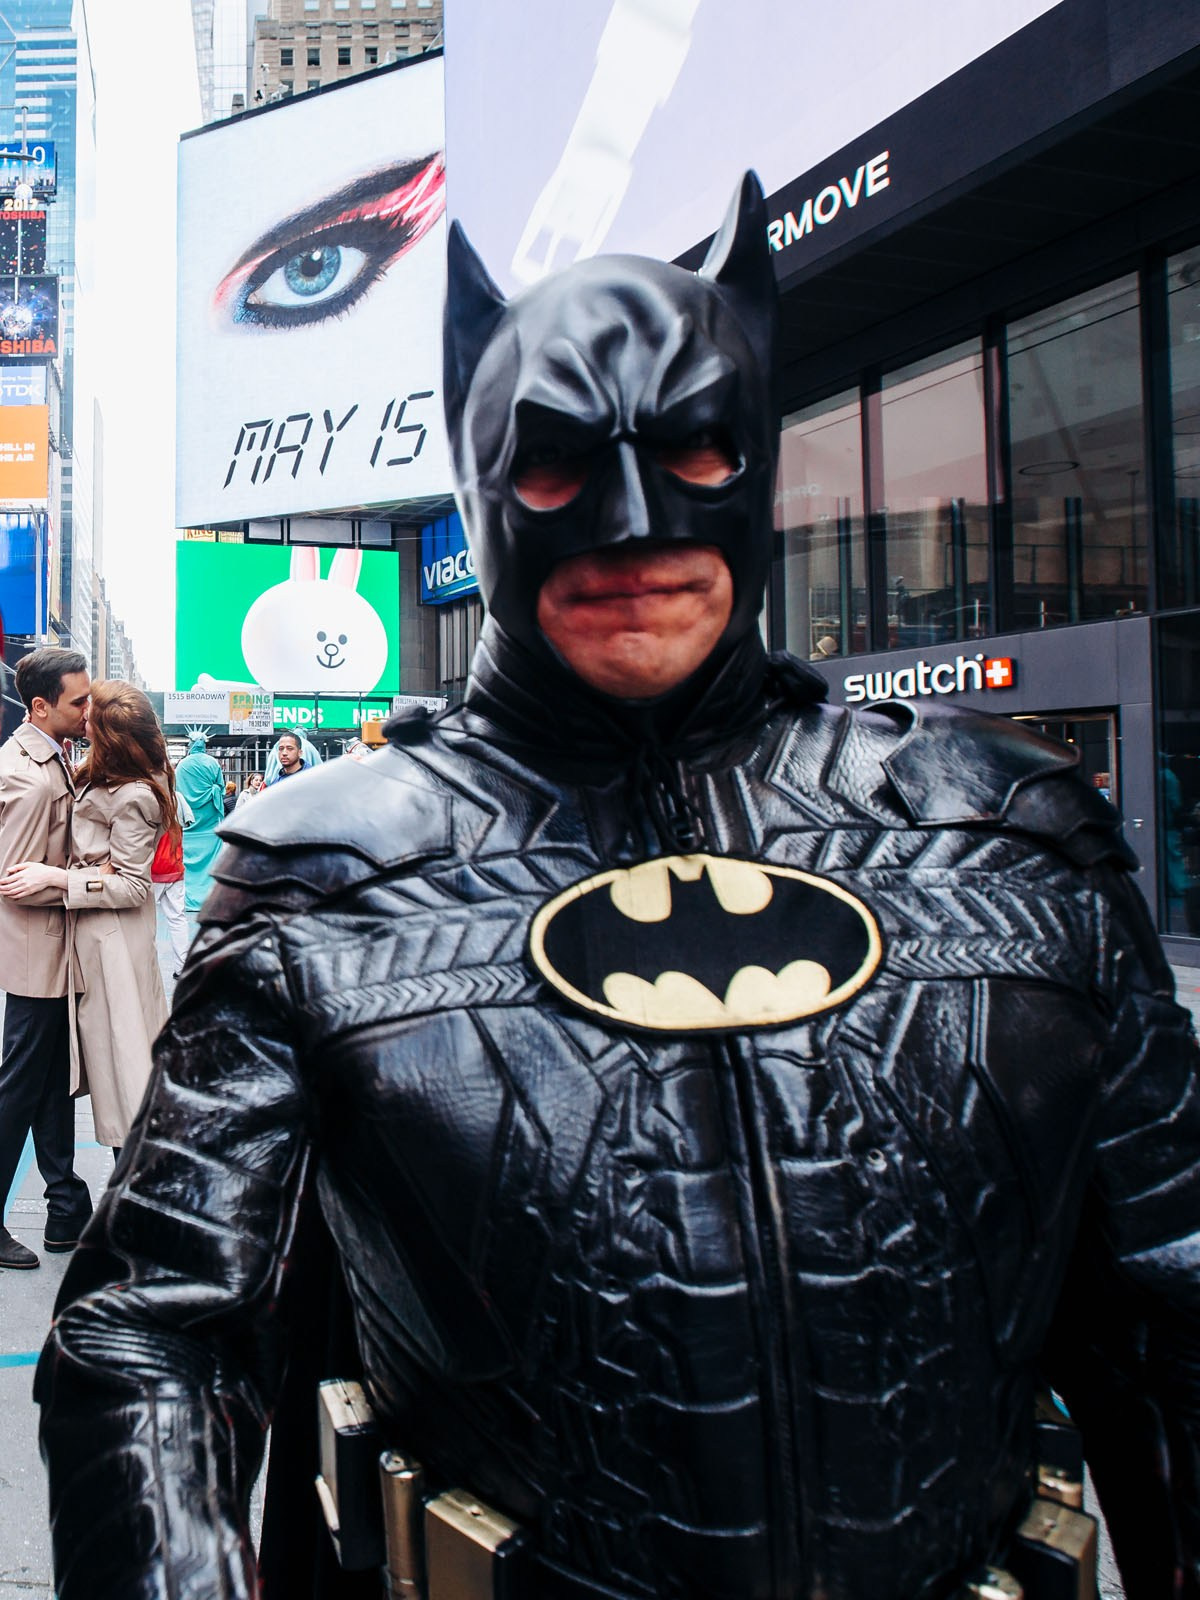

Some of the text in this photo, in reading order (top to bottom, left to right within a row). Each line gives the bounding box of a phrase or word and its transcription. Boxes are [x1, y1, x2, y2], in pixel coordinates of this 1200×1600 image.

[0, 146, 46, 165] 1:0
[3, 198, 39, 211] 2017
[3, 384, 43, 398] TDK
[223, 390, 434, 489] MAY 15
[23, 442, 35, 452] IN
[16, 453, 34, 461] AIR
[843, 653, 984, 702] swatch
[233, 694, 271, 704] SPRING
